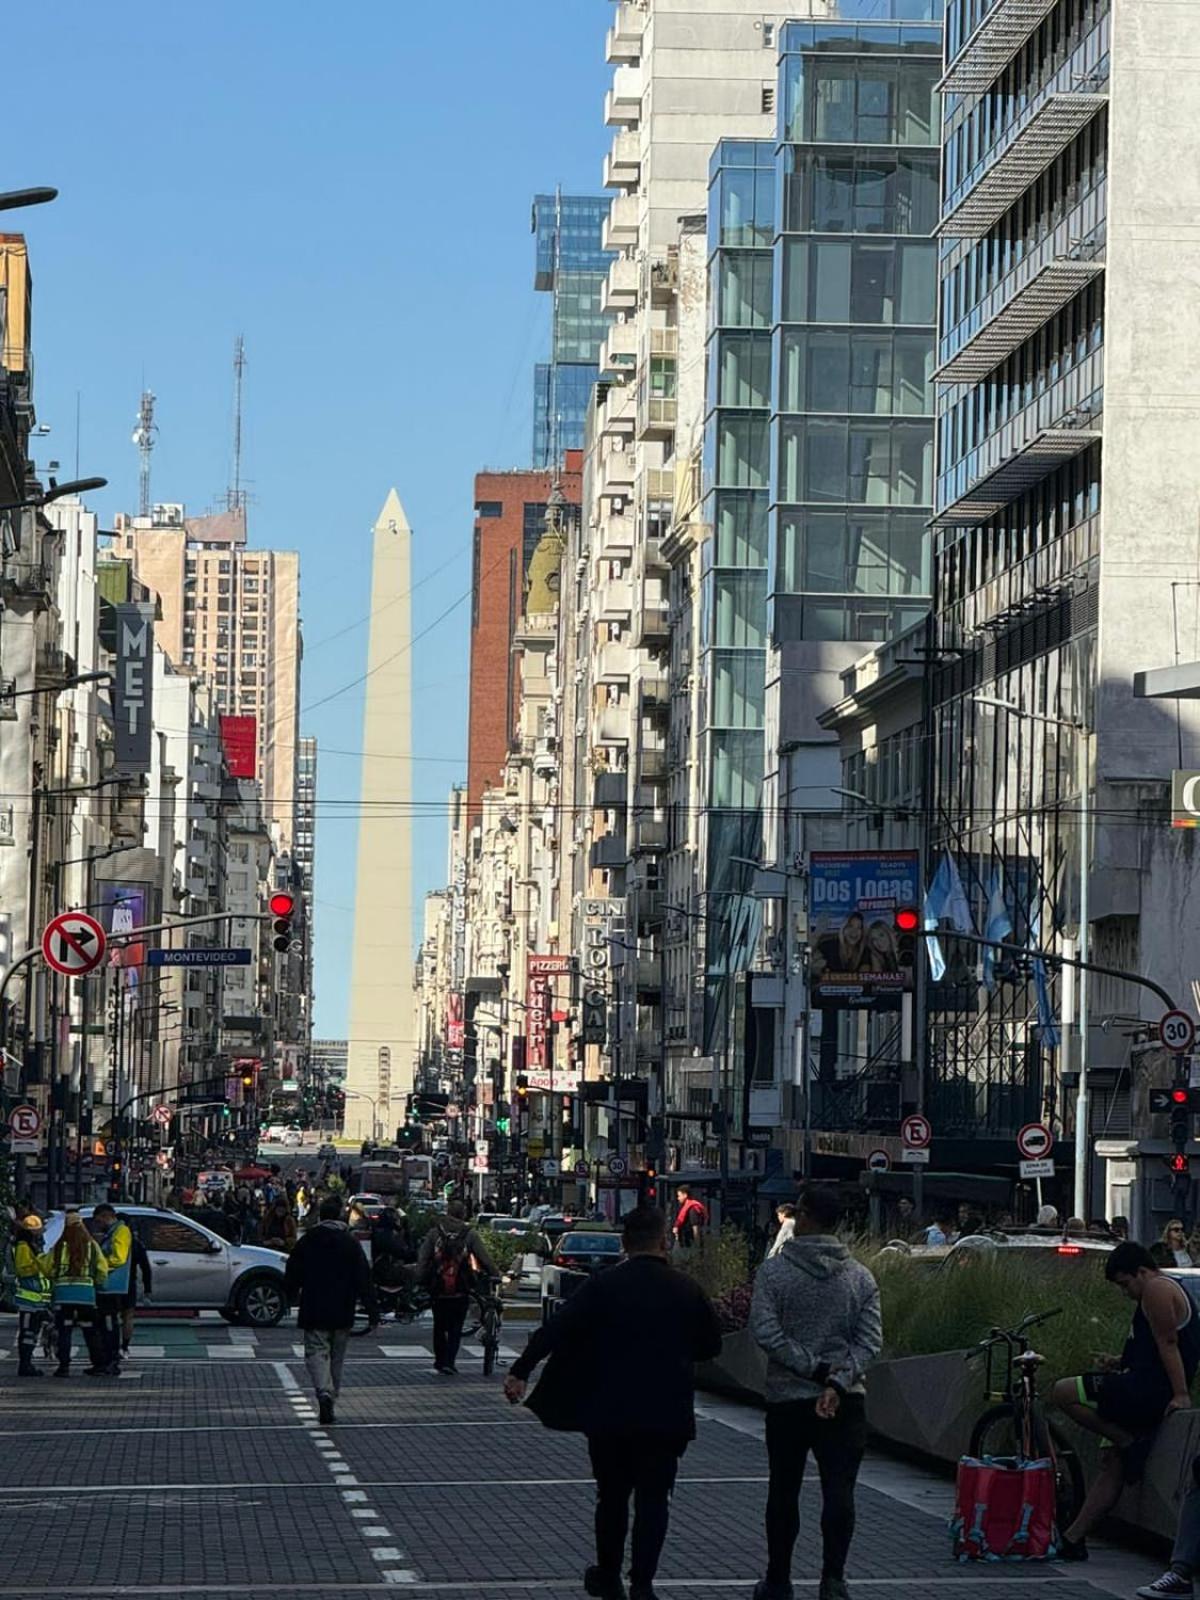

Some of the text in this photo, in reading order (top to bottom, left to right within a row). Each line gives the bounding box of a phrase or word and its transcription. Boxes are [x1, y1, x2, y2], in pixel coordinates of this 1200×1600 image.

[122, 620, 147, 735] MET
[813, 877, 914, 903] Dos Locas
[163, 952, 236, 962] MONTEVIDEO
[1166, 1022, 1187, 1040] 30
